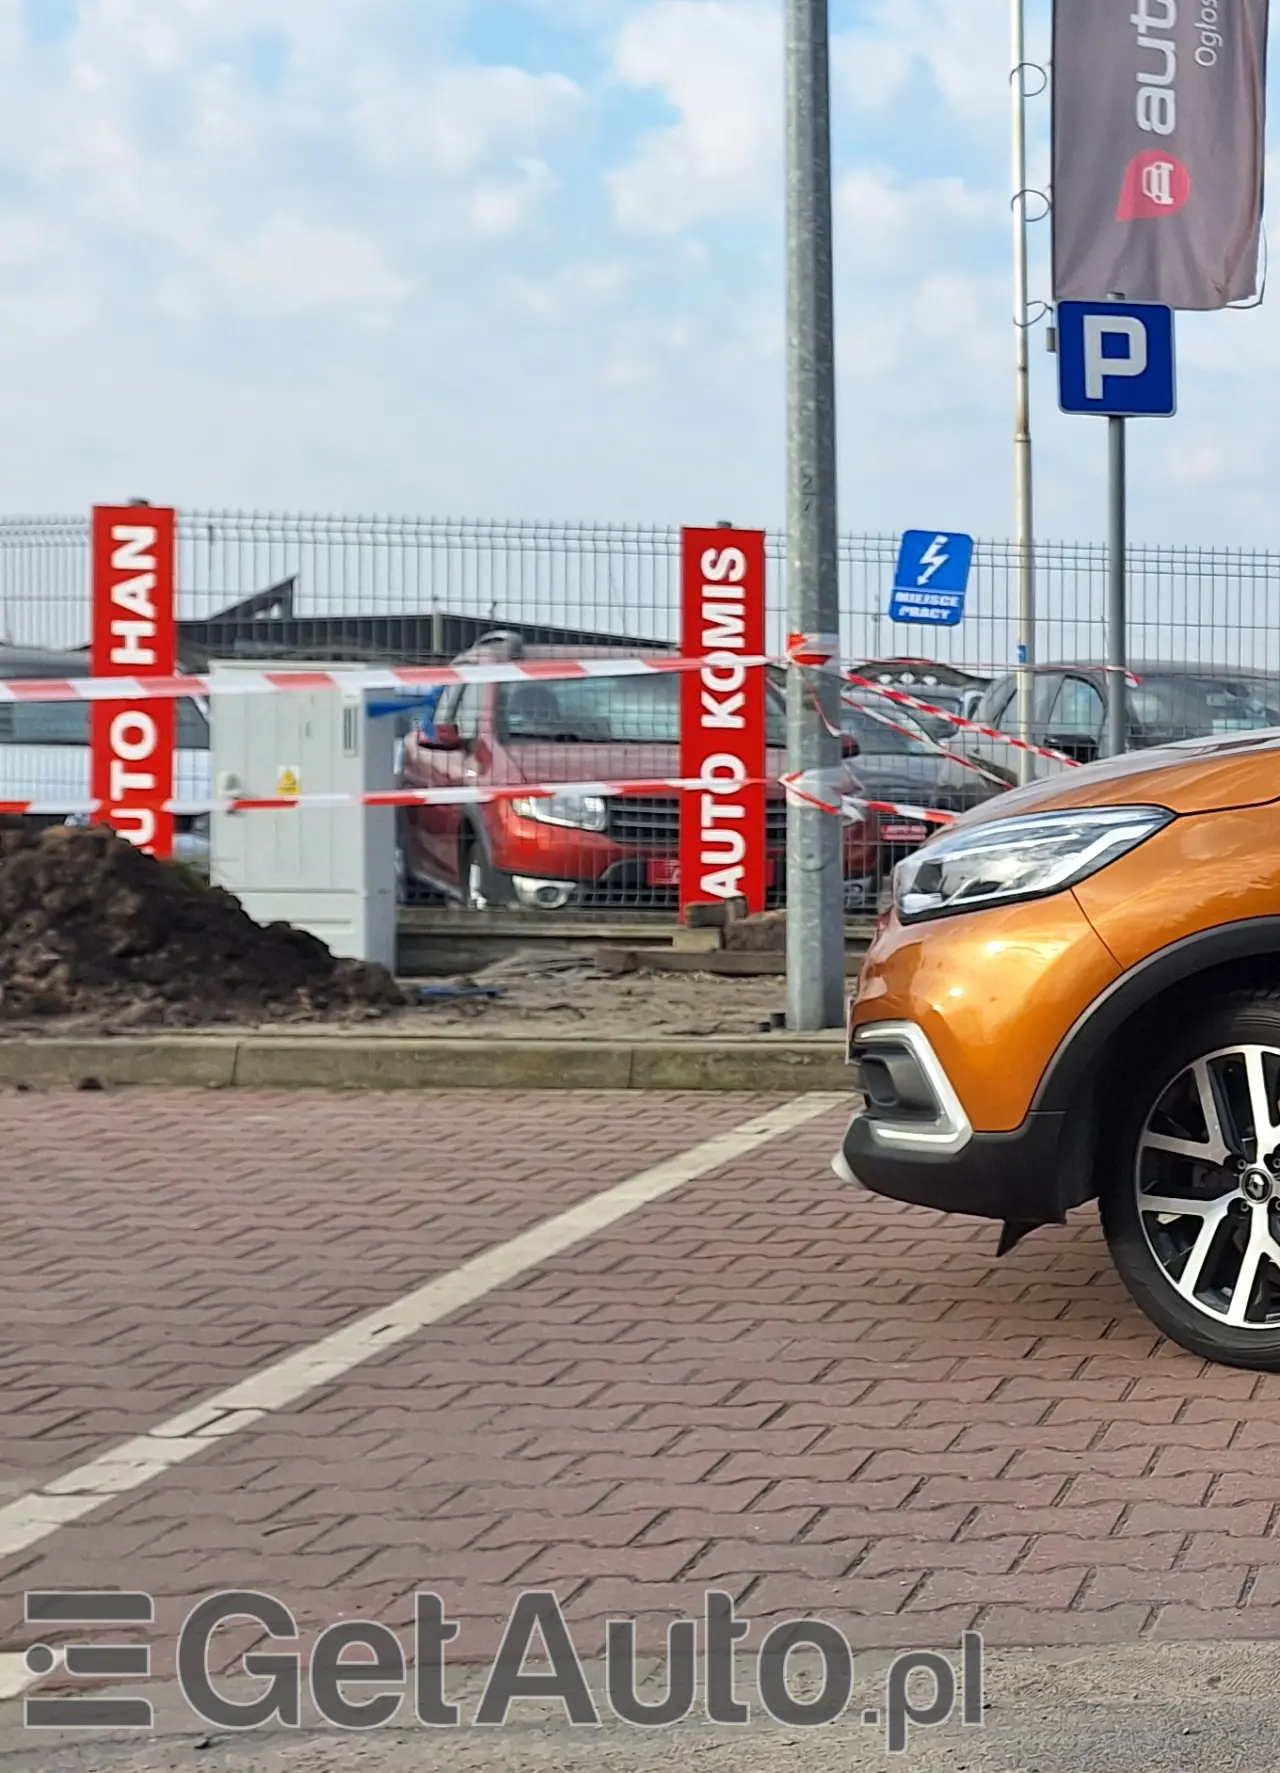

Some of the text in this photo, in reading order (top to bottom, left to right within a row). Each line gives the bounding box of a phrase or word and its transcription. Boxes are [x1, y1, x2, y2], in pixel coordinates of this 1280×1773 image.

[1083, 315, 1147, 399] P
[110, 525, 157, 855] UTO HAN
[701, 546, 747, 897] AUTO KOMIS
